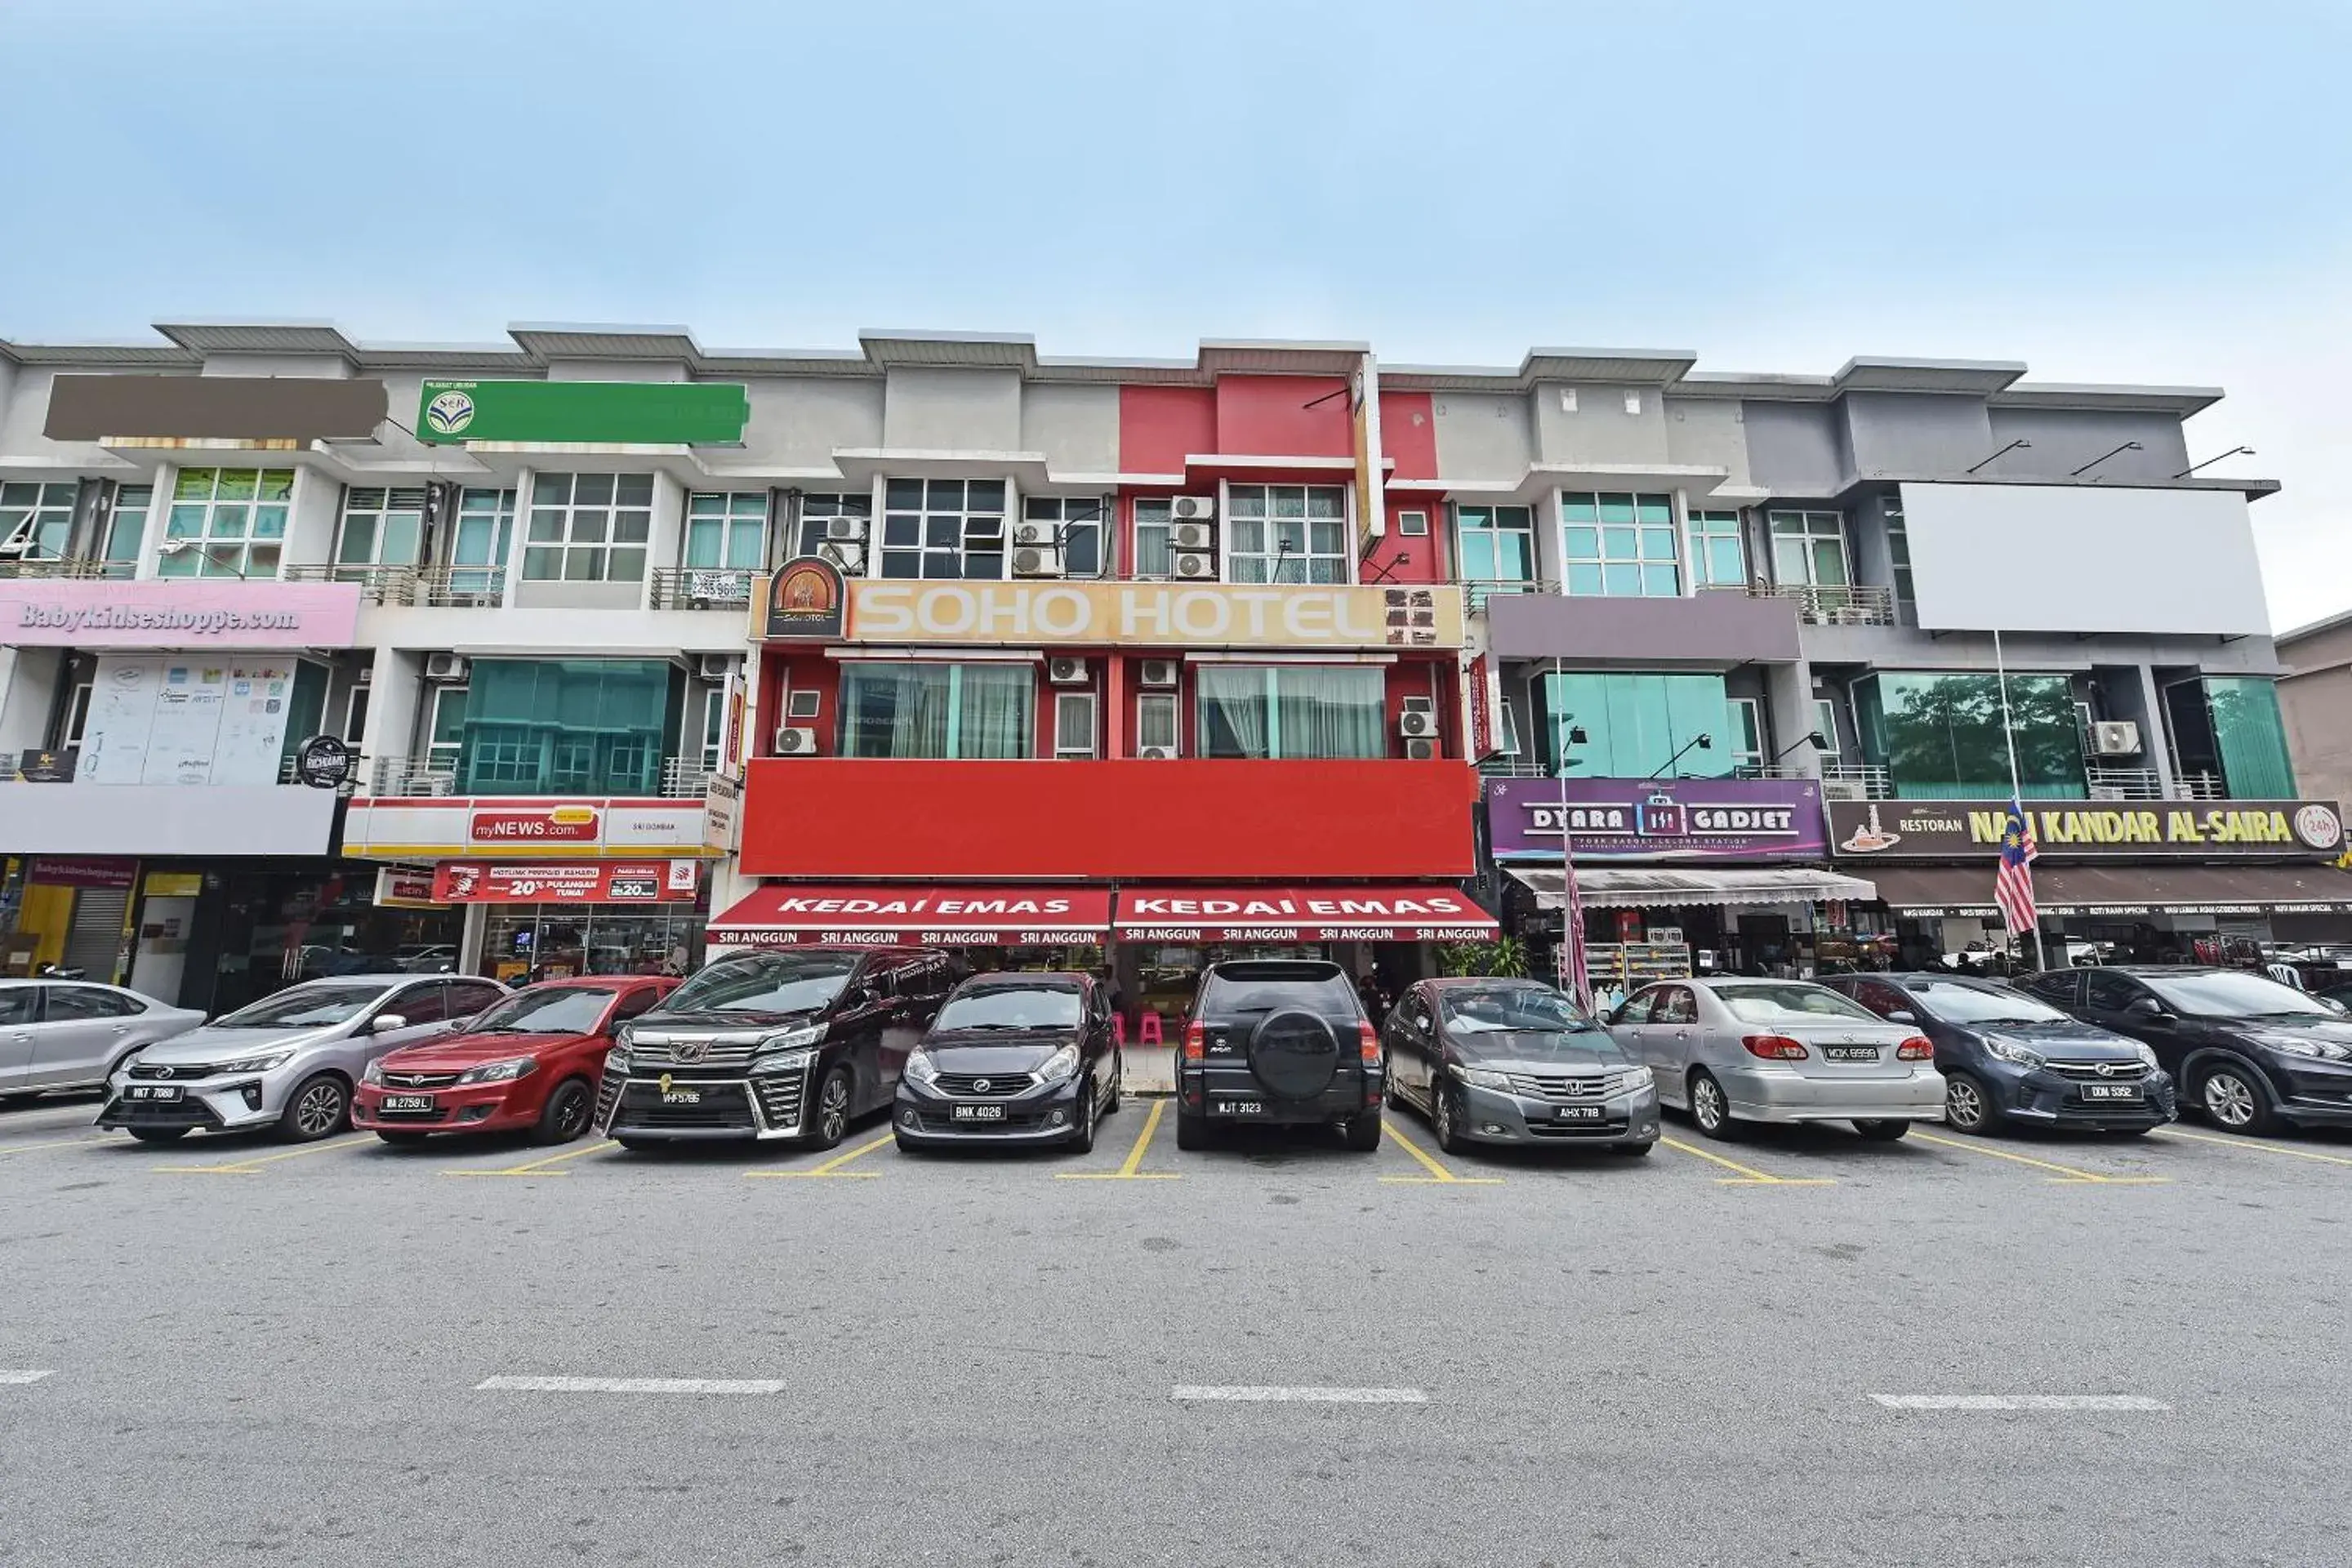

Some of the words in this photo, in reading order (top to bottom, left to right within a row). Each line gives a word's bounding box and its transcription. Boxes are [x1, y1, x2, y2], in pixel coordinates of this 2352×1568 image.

[858, 586, 1092, 636] SOHO
[1121, 590, 1377, 639] HOTEL
[19, 604, 300, 633] Babykidseshoppe.com
[1533, 810, 1624, 827] DYARA
[1694, 810, 1792, 829] GADJET
[1900, 819, 1963, 832] RESTORAN
[2042, 811, 2162, 844] KANDAR
[2167, 810, 2293, 843] AL-SAIRA
[778, 898, 928, 914] KEDAI
[935, 899, 1069, 914] EMAS
[1135, 899, 1296, 915] KEDAI
[1307, 898, 1463, 915] EMAS
[719, 933, 738, 943] SRI
[741, 933, 797, 943] ANGGUN
[822, 933, 840, 943] SRI
[842, 933, 898, 943] ANGGUN
[922, 933, 940, 943] SRI
[942, 933, 998, 943] ANGGUN
[1021, 933, 1039, 943] SRI
[1042, 933, 1097, 943] ANGGUN
[1125, 929, 1144, 939] SRI
[1146, 929, 1200, 939] ANGGUN
[1223, 929, 1241, 939] SRI
[1244, 929, 1298, 939] ANGGUN
[1320, 929, 1338, 939] SRI
[1340, 929, 1393, 939] ANGGUN
[1417, 929, 1435, 939] SRI
[1437, 929, 1490, 939] ANGGUN
[956, 1107, 974, 1117] BNK
[977, 1107, 1001, 1117] 4026
[1240, 1102, 1261, 1113] 3123
[1560, 1107, 1580, 1117] AHX
